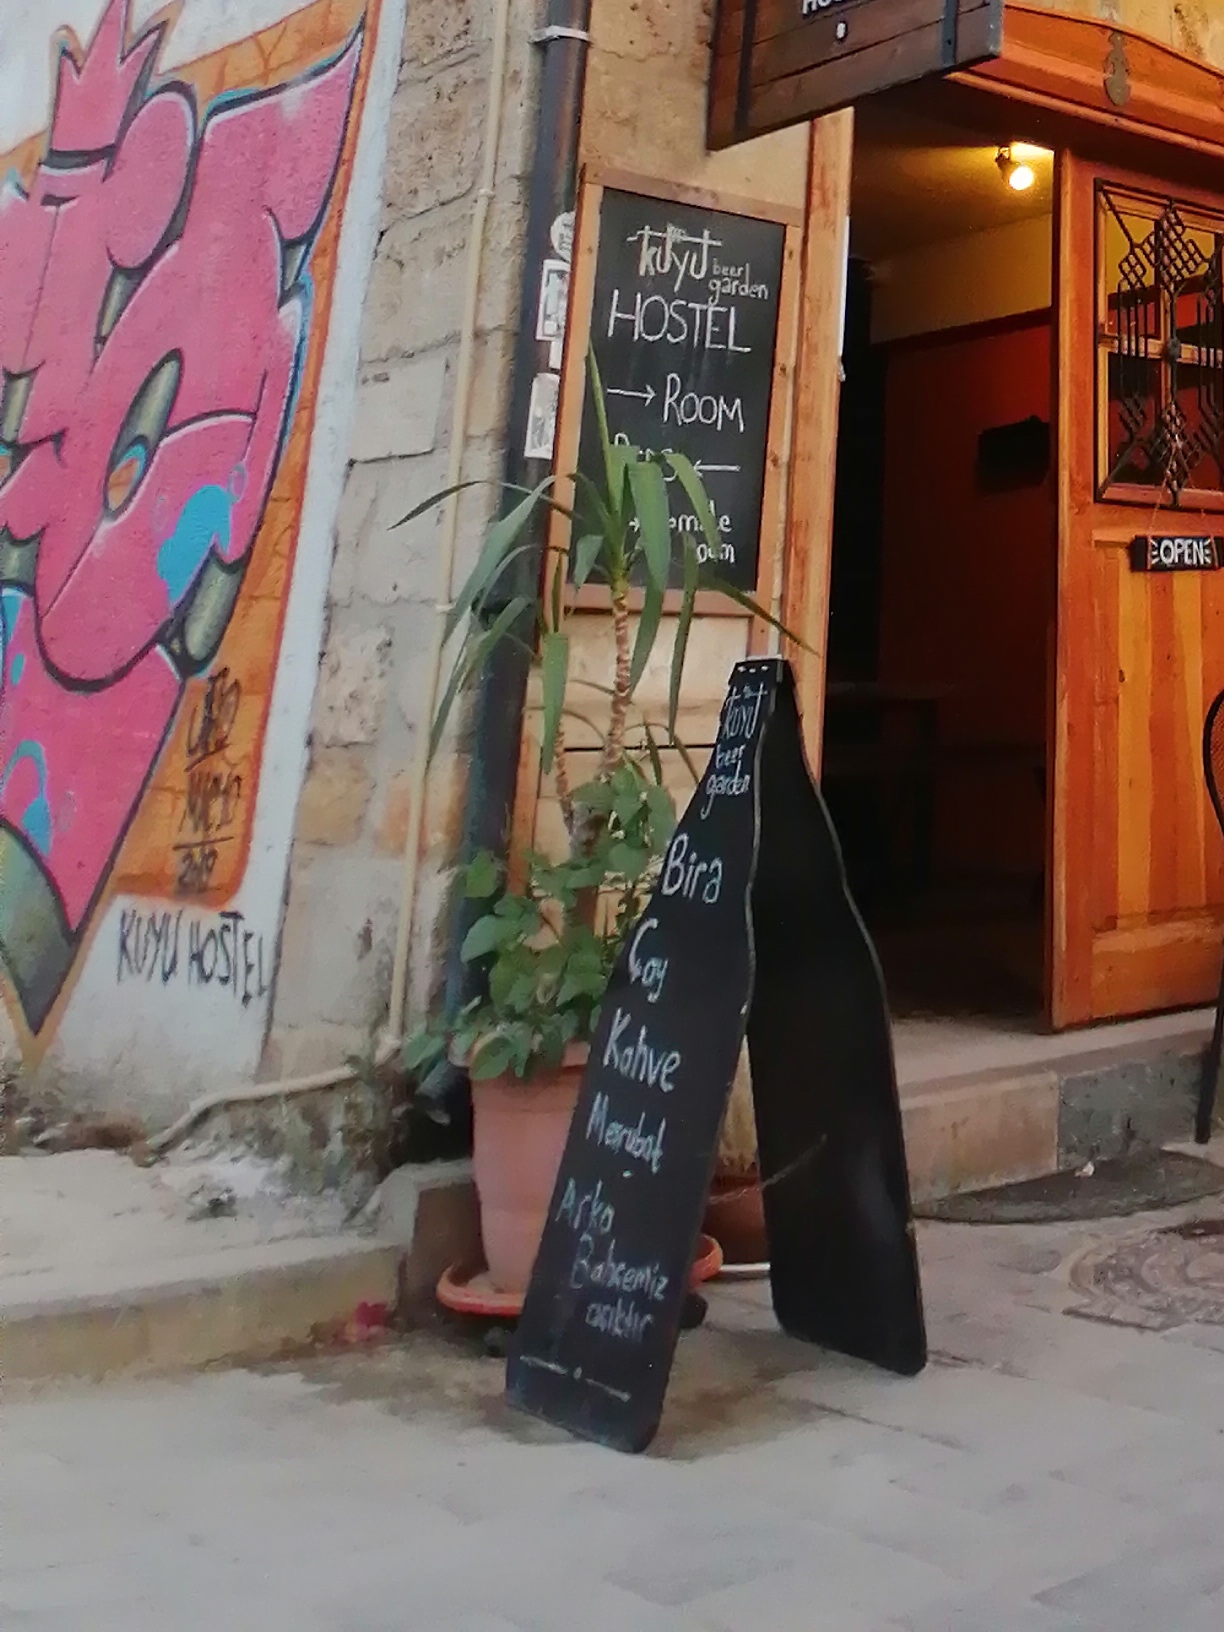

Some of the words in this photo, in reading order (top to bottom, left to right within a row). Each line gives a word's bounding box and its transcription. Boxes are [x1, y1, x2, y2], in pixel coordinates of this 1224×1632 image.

[708, 262, 769, 306] garden
[607, 288, 752, 353] HOSTEL
[1159, 538, 1205, 566] OPEN
[700, 759, 750, 820] garden
[661, 832, 723, 904] Bira
[188, 911, 268, 1008] HOSTEL
[603, 1006, 681, 1093] Kahve
